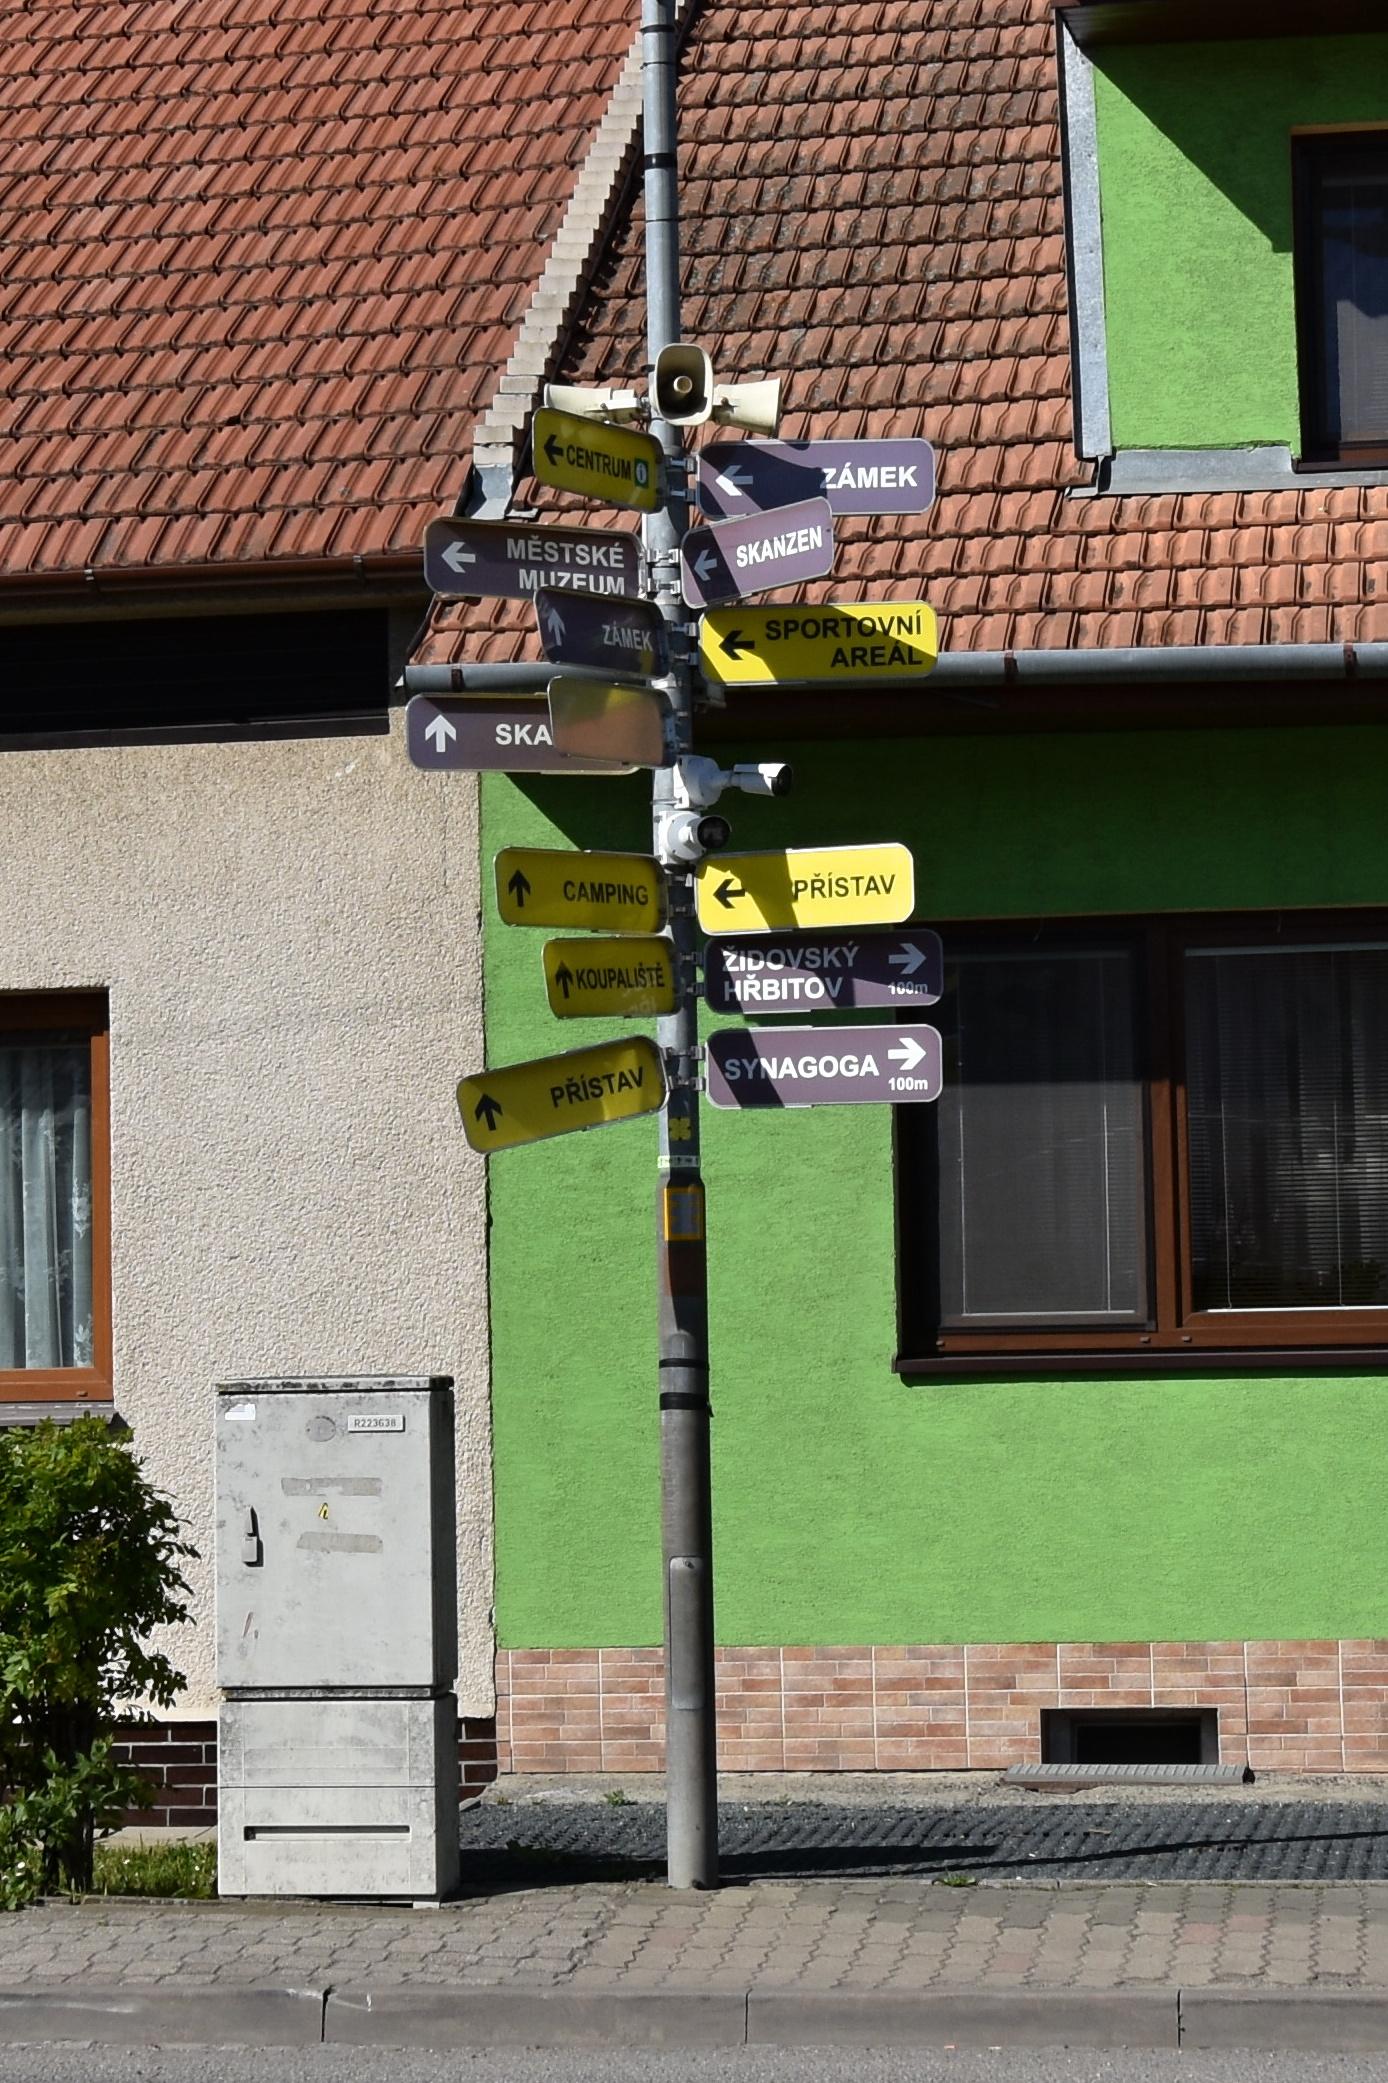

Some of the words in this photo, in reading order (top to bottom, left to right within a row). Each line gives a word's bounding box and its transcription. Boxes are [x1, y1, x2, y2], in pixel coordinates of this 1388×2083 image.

[566, 444, 632, 480] CENTRUM
[820, 462, 918, 490] ZÁMEK
[506, 535, 625, 568] MĚSTSKÉ
[736, 525, 823, 568] SKANZEN
[601, 620, 654, 651] ZÁMEK
[765, 609, 922, 641] SPORTOVNÍ
[830, 640, 923, 668] AREÁL
[495, 723, 553, 746] SKA
[563, 879, 649, 906] CAMPING
[793, 871, 896, 900] PŘÍSTAV
[722, 941, 861, 972] ŽIDOVSKÝ
[575, 962, 665, 990] KOUPALIŠTĚ
[724, 973, 844, 1001] HŘBITOV
[887, 980, 929, 995] 100m
[724, 1054, 880, 1080] SYNAGOGA
[550, 1066, 644, 1108] PŘÍSTAV
[887, 1077, 929, 1091] 100m
[354, 1418, 397, 1428] R223638
